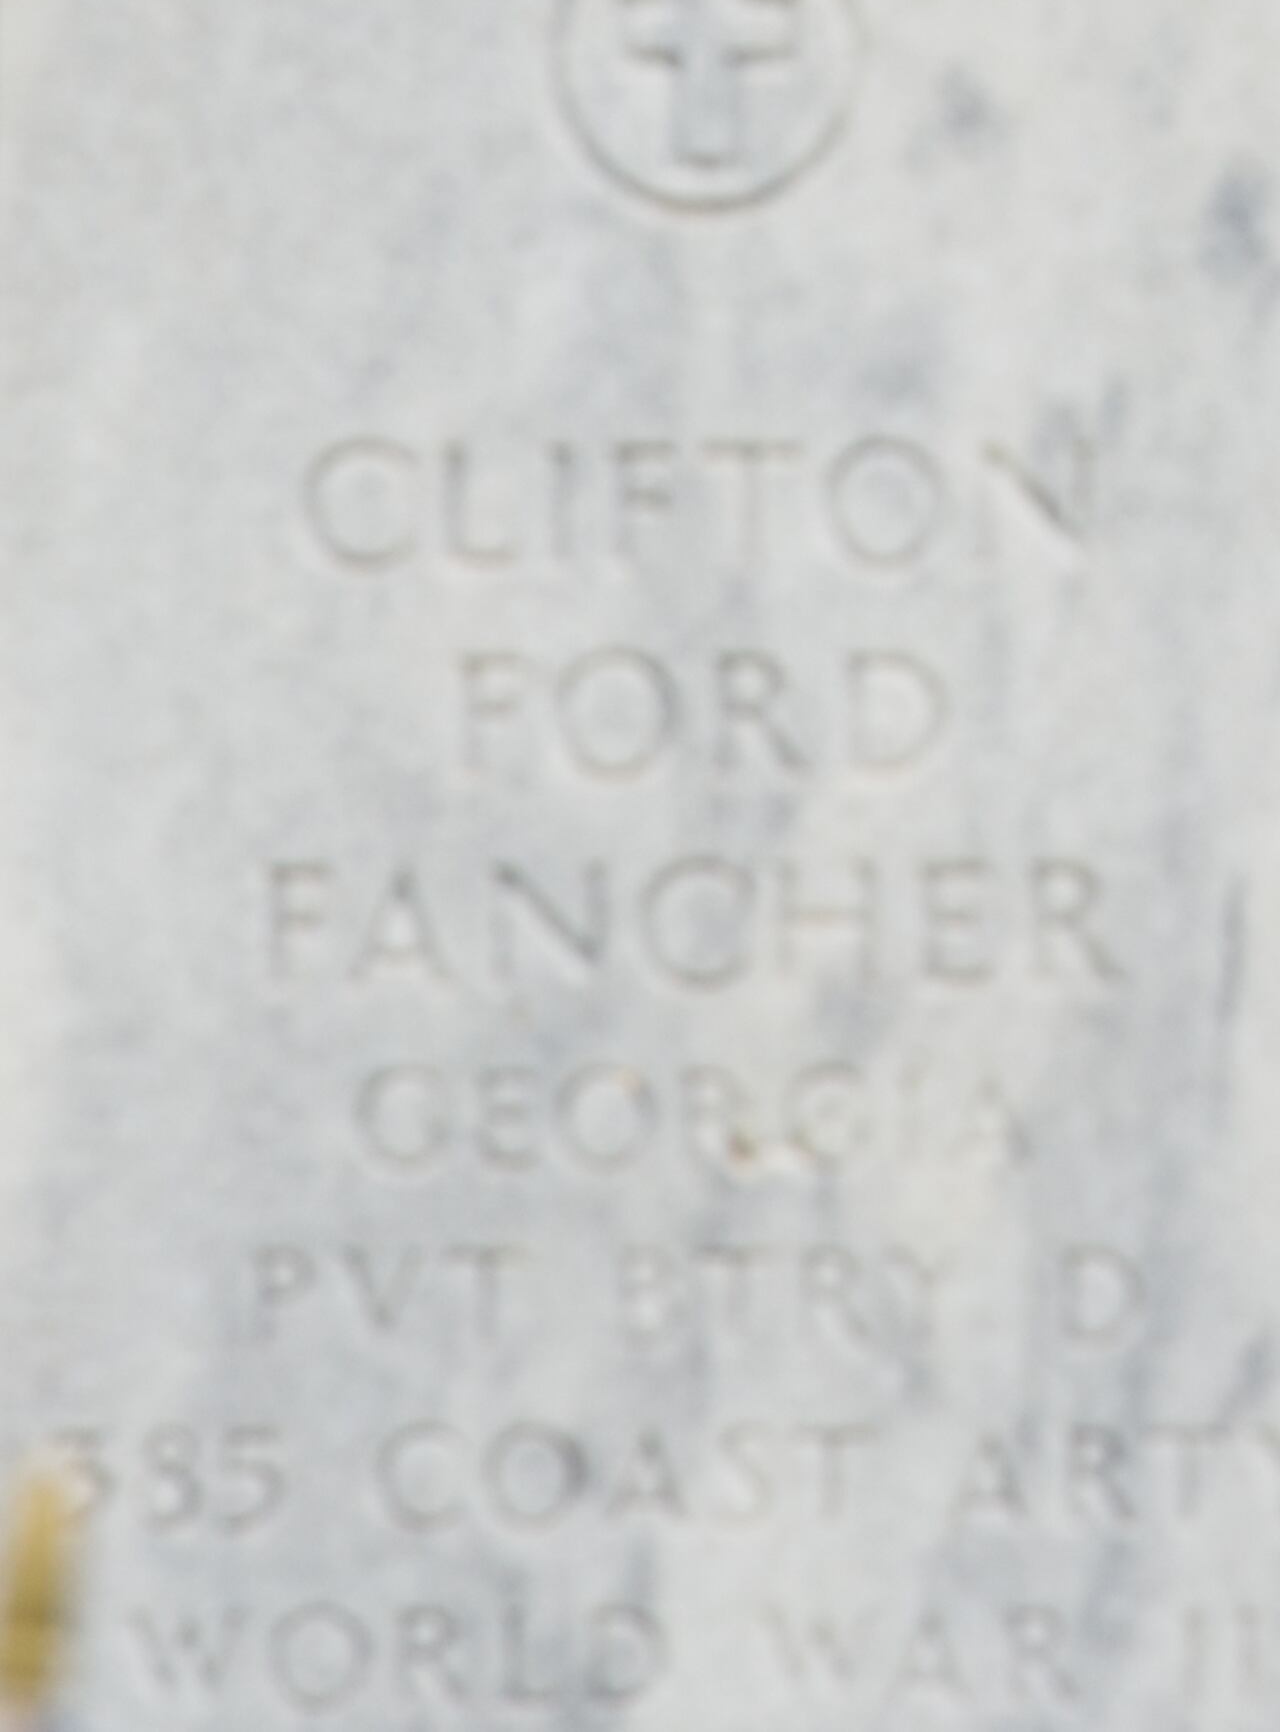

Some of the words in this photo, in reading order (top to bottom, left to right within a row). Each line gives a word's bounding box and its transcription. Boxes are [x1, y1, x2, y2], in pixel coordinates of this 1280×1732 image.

[298, 434, 1097, 572] CLIFTON
[457, 646, 949, 782] FORD
[264, 854, 1128, 990] FANCHER
[250, 1244, 523, 1339] PVT
[1056, 1244, 1146, 1340] D
[375, 1421, 880, 1536] COAST
[129, 1600, 670, 1714] WORLD
[766, 1604, 1083, 1704] WAR
